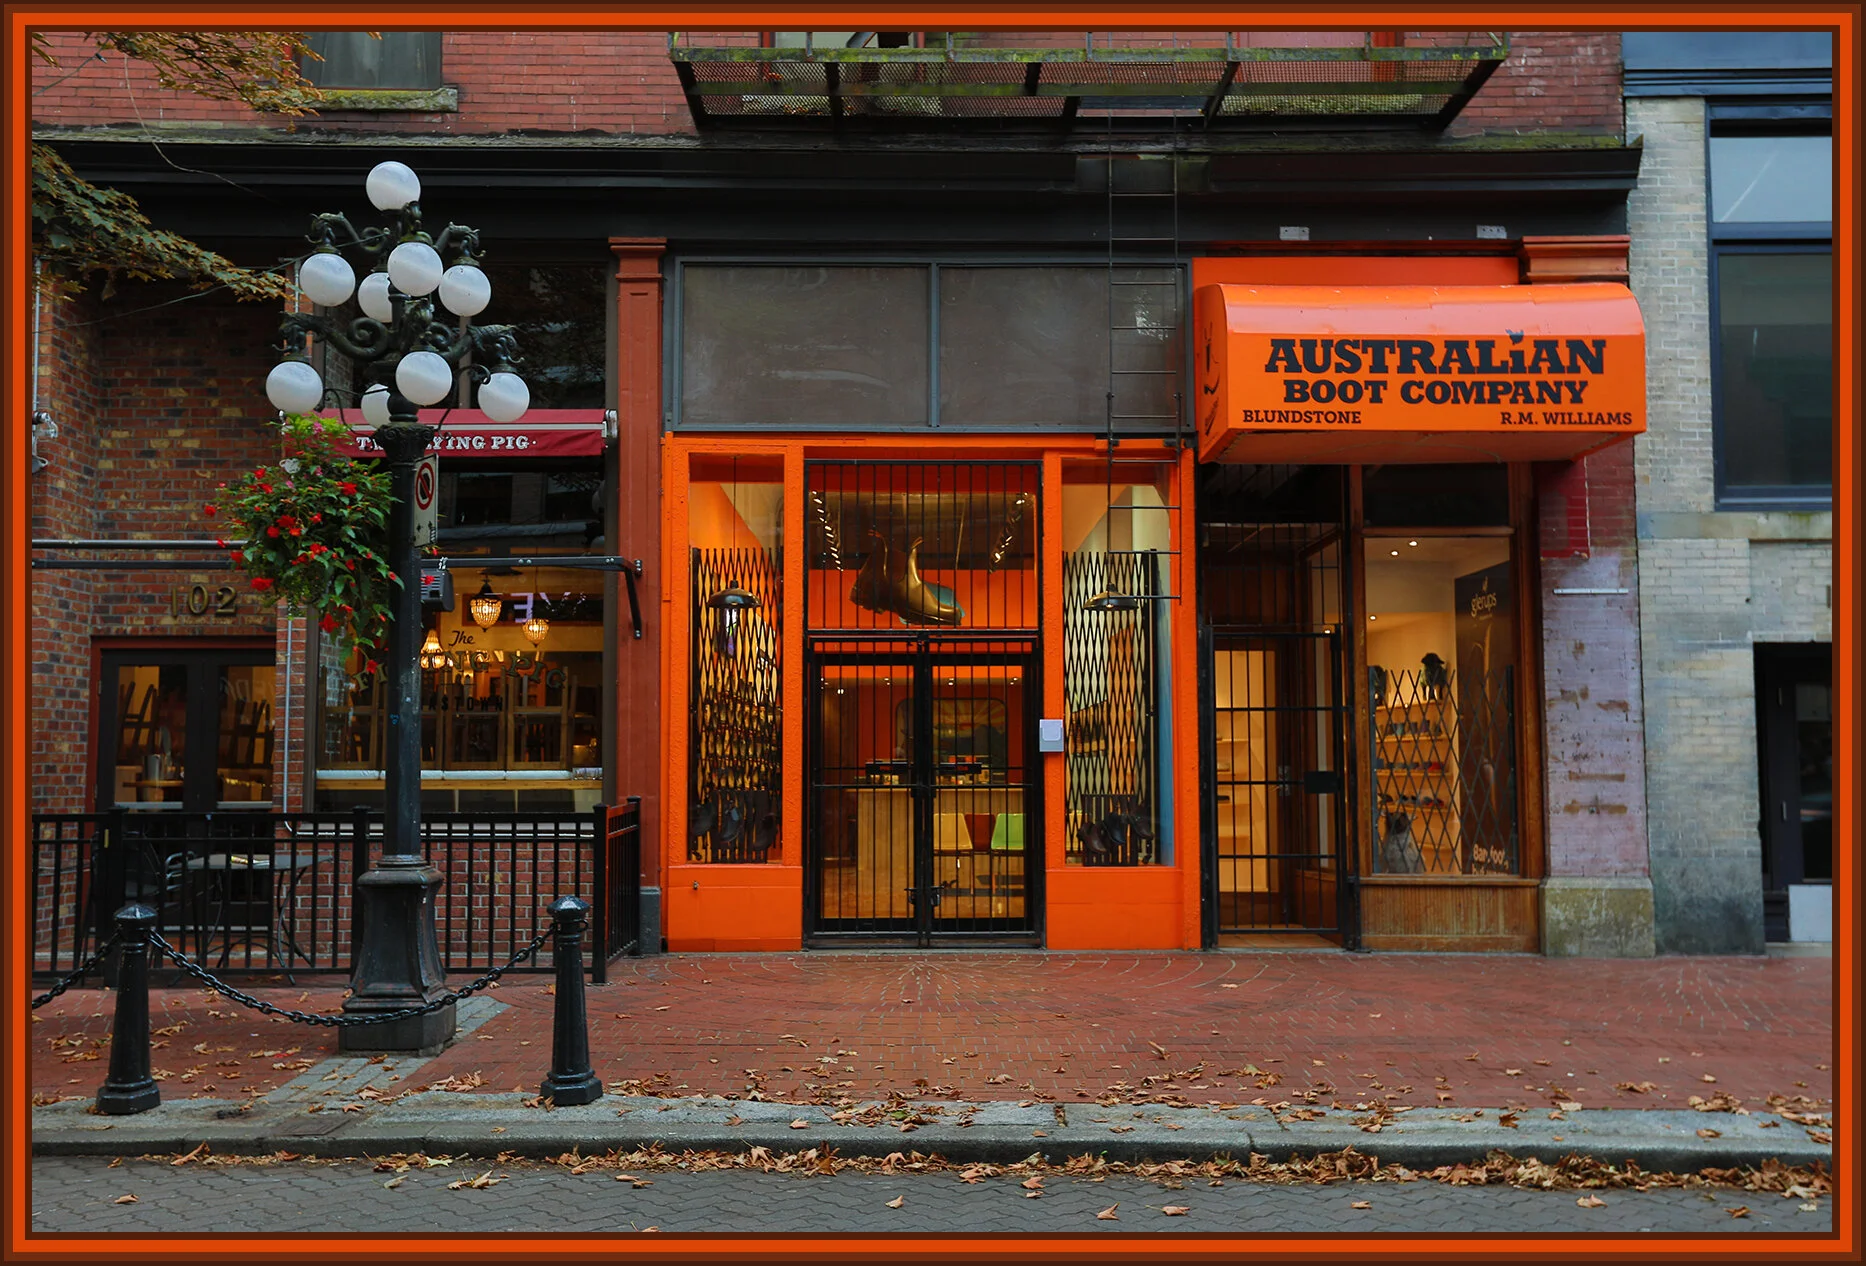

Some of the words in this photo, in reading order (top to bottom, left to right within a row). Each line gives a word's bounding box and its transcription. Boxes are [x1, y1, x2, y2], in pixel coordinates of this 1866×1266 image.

[1283, 380, 1388, 404] BOOT
[1400, 380, 1589, 405] COMPANY
[1243, 409, 1362, 424] BLUNDSTONE
[1501, 411, 1539, 425] R.M.
[1542, 411, 1633, 425] WILLIAMS
[491, 435, 530, 450] PIG
[171, 584, 237, 616] 102
[448, 630, 476, 647] The
[505, 653, 567, 689] PIG
[421, 694, 503, 711] ASTOWN
